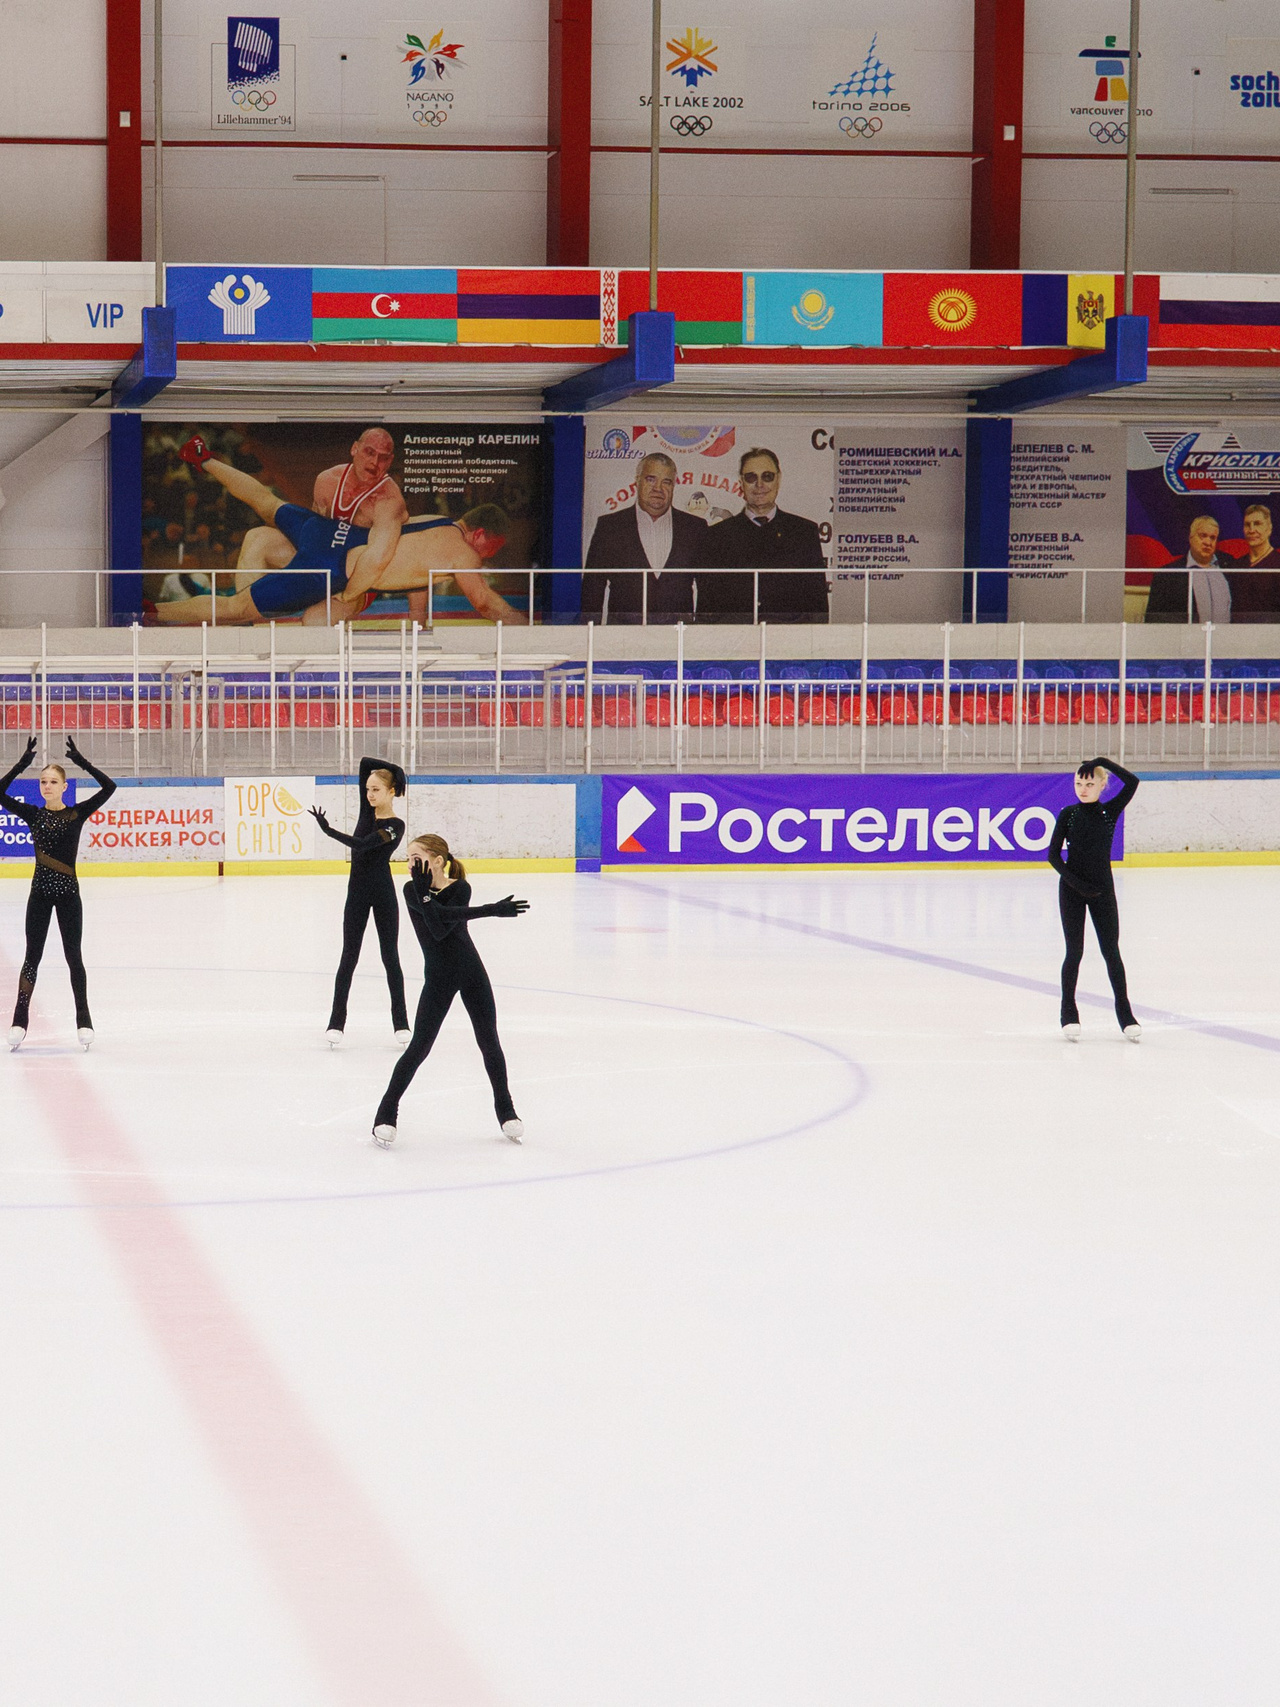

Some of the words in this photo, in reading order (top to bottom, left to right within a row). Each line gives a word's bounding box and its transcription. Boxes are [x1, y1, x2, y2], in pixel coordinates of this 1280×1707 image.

[1230, 71, 1280, 91] soch
[406, 92, 454, 102] NAGANO
[639, 96, 671, 108] SAT
[674, 96, 709, 108] LAKE
[712, 97, 744, 108] 2002
[812, 100, 862, 111] torino
[868, 102, 911, 112] 2006
[1070, 106, 1124, 116] vancouver
[86, 303, 124, 329] VIP
[404, 434, 474, 446] Александр
[478, 435, 540, 445] КАРЕЛИН
[404, 448, 462, 456] Трехкратный
[839, 446, 936, 457] РОМИШЕВСКИЙ
[939, 448, 962, 457] И.А.
[1067, 444, 1078, 453] С.
[1081, 444, 1095, 453] М.
[838, 458, 890, 466] СОВЕТСКИЙ
[893, 459, 941, 467] ХОККЕИСТ,
[1011, 454, 1070, 462] ЛИМПИЙСКИЙ
[838, 468, 922, 476] ЧЕТЫРЕХКРАТНЫЙ
[1010, 465, 1064, 473] ОБЕДИТЕЛЬ,
[1010, 473, 1066, 481] РЕХКРАТНЫЙ
[1182, 471, 1258, 479] СПОРТИВНЫЙ
[700, 472, 746, 499] ШАЙ
[884, 478, 910, 486] МИРА,
[838, 486, 898, 495] ДВУКРАТНЫЙ
[838, 495, 906, 503] ОЛИМПИЙСКИЙ
[838, 534, 894, 544] ГОЛУБЕВ
[896, 534, 920, 544] В.А.
[1009, 533, 1058, 542] ОЛУБЕВ
[1061, 533, 1084, 542] В.А.
[837, 545, 905, 553] ЗАСЛУЖЕННЫЙ
[1009, 543, 1070, 551] АСЛУЖЕННЫЙ
[234, 782, 271, 818] TOP
[89, 808, 213, 828] ФЕДЕРАЦИЯ
[668, 792, 1069, 853] Ростелеко
[88, 832, 172, 848] ХОККЕЯ
[178, 831, 225, 846] РОС
[237, 820, 302, 857] CHIPS
